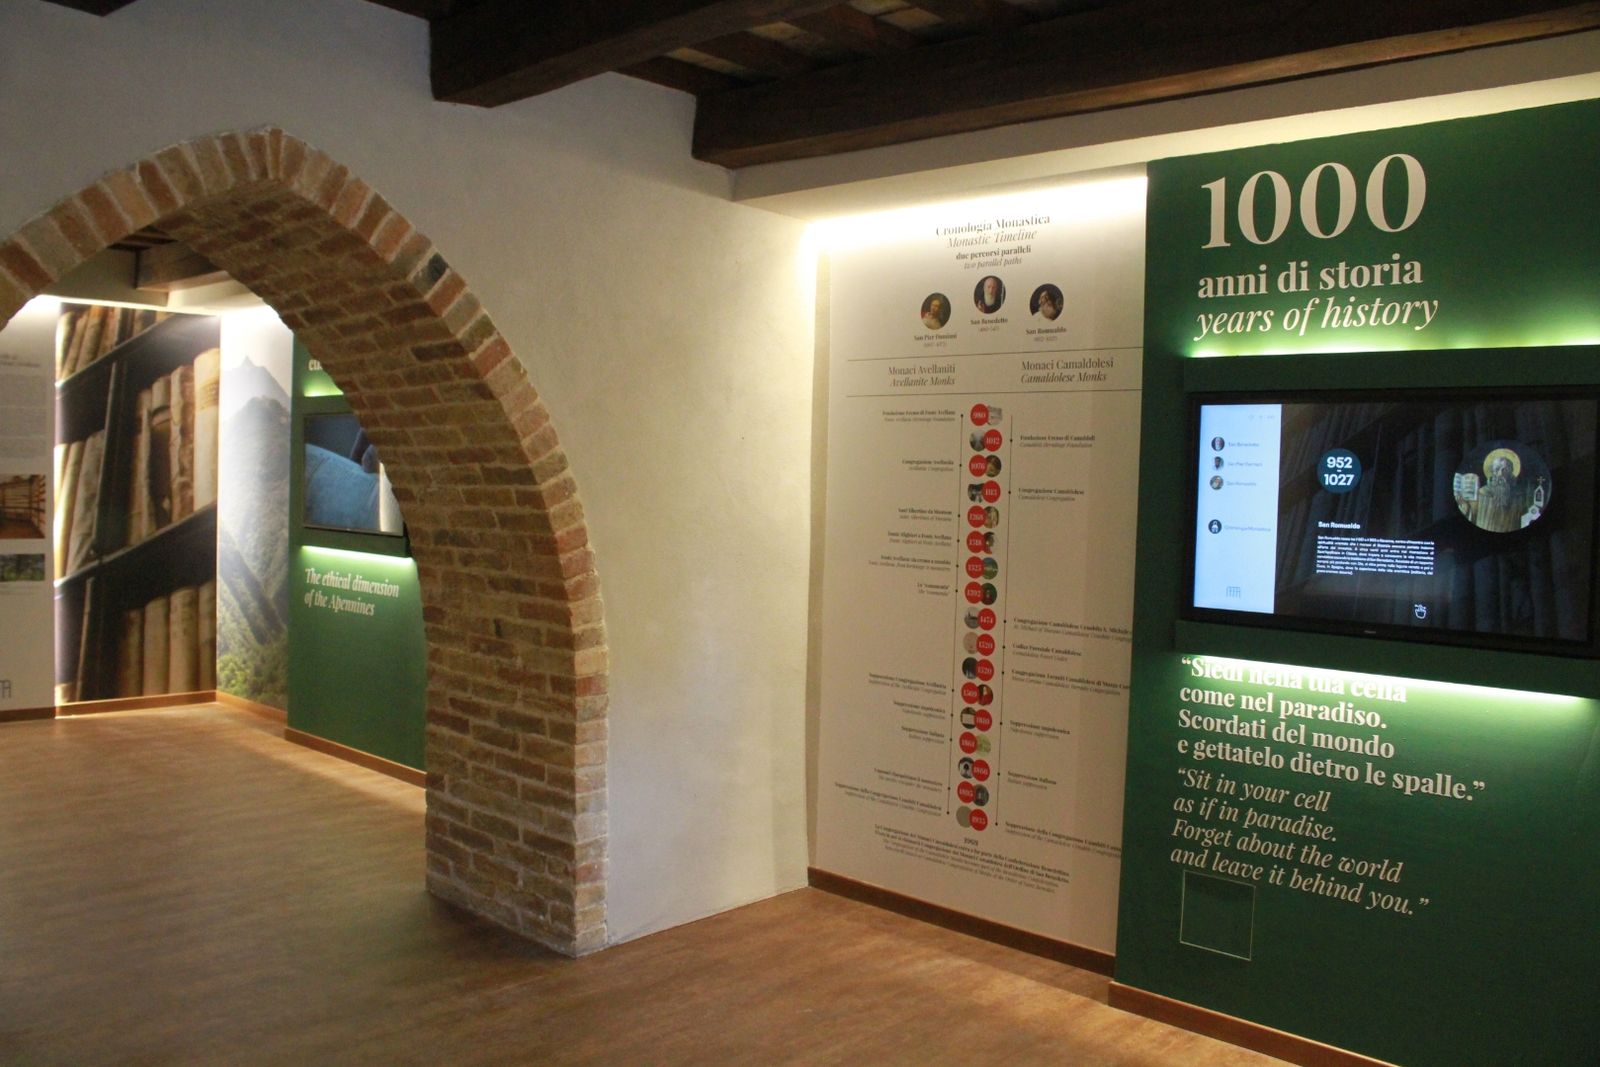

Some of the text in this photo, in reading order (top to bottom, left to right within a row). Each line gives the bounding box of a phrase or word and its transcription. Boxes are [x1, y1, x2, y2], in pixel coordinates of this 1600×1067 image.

[1201, 153, 1426, 249] 1000
[936, 215, 1050, 236] Cronologia Monastica
[947, 229, 1038, 248] Monastic Timeline
[956, 245, 1031, 261] due percorsi paralleli
[977, 258, 1002, 269] parallel
[1003, 257, 1022, 267] paths
[1197, 253, 1423, 298] anni di storia
[1193, 296, 1438, 342] years of history
[888, 363, 955, 375] Monaci Avellaniti
[1021, 357, 1113, 370] Monaci Camaldolesi
[930, 376, 955, 386] Monks
[1021, 371, 1107, 384] Camaldolese Monks
[1326, 456, 1353, 468] 952
[1324, 474, 1355, 486] 1027
[1318, 521, 1361, 530] San Romualdo
[305, 567, 400, 598] The ethical dimension
[304, 589, 375, 616] of the Apennines
[1308, 669, 1344, 695] tua
[1180, 686, 1388, 729] come nel paradiso.
[1178, 708, 1395, 759] Scordati del mondo
[1177, 739, 1189, 754] e
[1193, 739, 1285, 769] gettatelo
[1290, 752, 1360, 783] dietro
[1364, 762, 1387, 786] le
[1215, 773, 1236, 795] in
[1240, 781, 1289, 805] your
[1293, 790, 1332, 813] cell
[1173, 796, 1338, 842] as if in paradise.
[1171, 818, 1404, 884] Forget about the world
[1169, 848, 1209, 869] and
[1212, 852, 1264, 881] leave
[1268, 863, 1286, 886] it
[1288, 867, 1365, 904] behind
